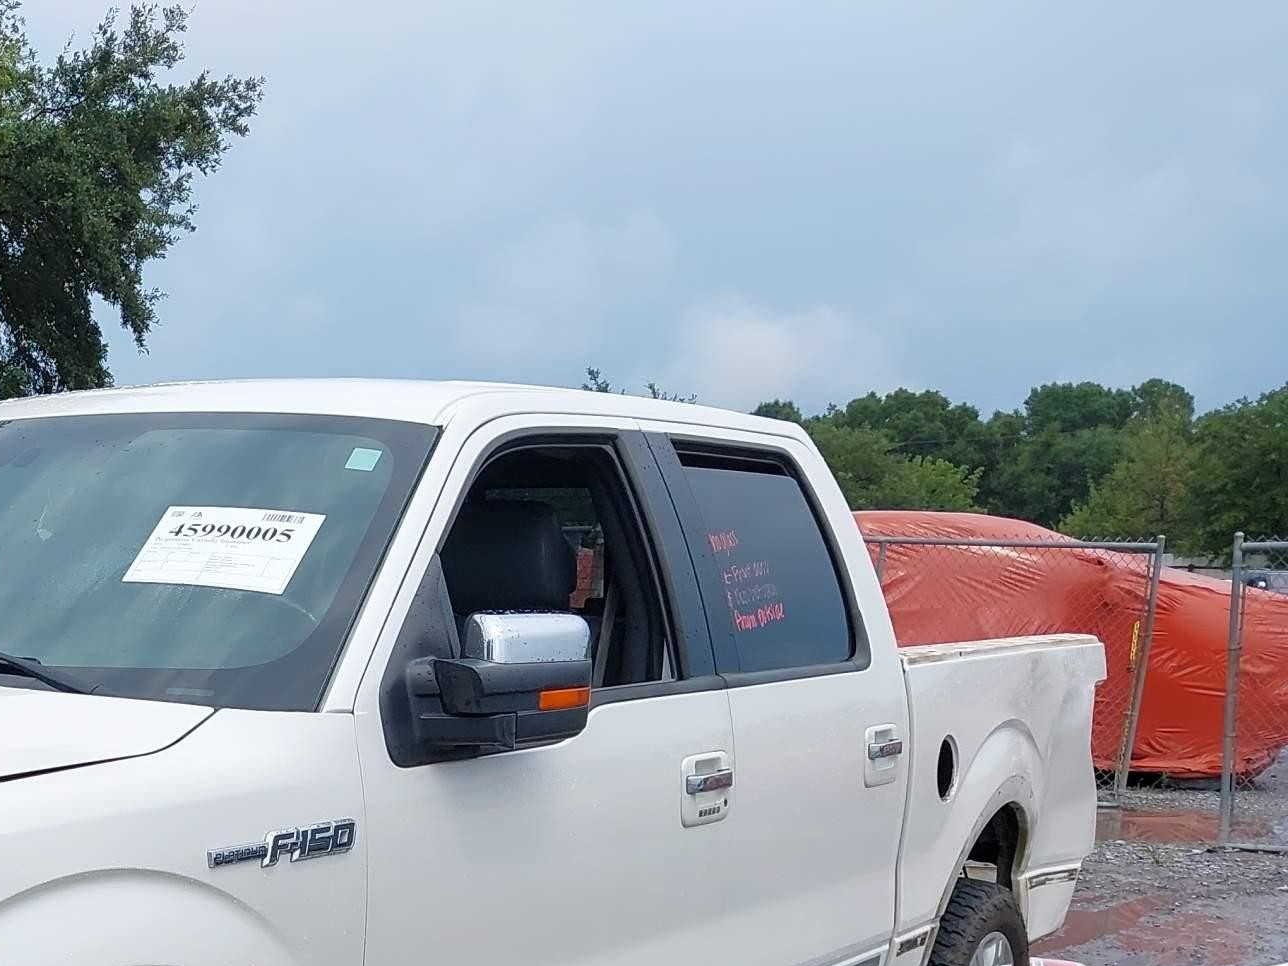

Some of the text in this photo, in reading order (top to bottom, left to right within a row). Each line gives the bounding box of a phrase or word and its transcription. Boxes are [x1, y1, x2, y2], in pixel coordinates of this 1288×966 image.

[169, 523, 296, 543] 45990005
[214, 818, 357, 867] PLATINUM F-150
